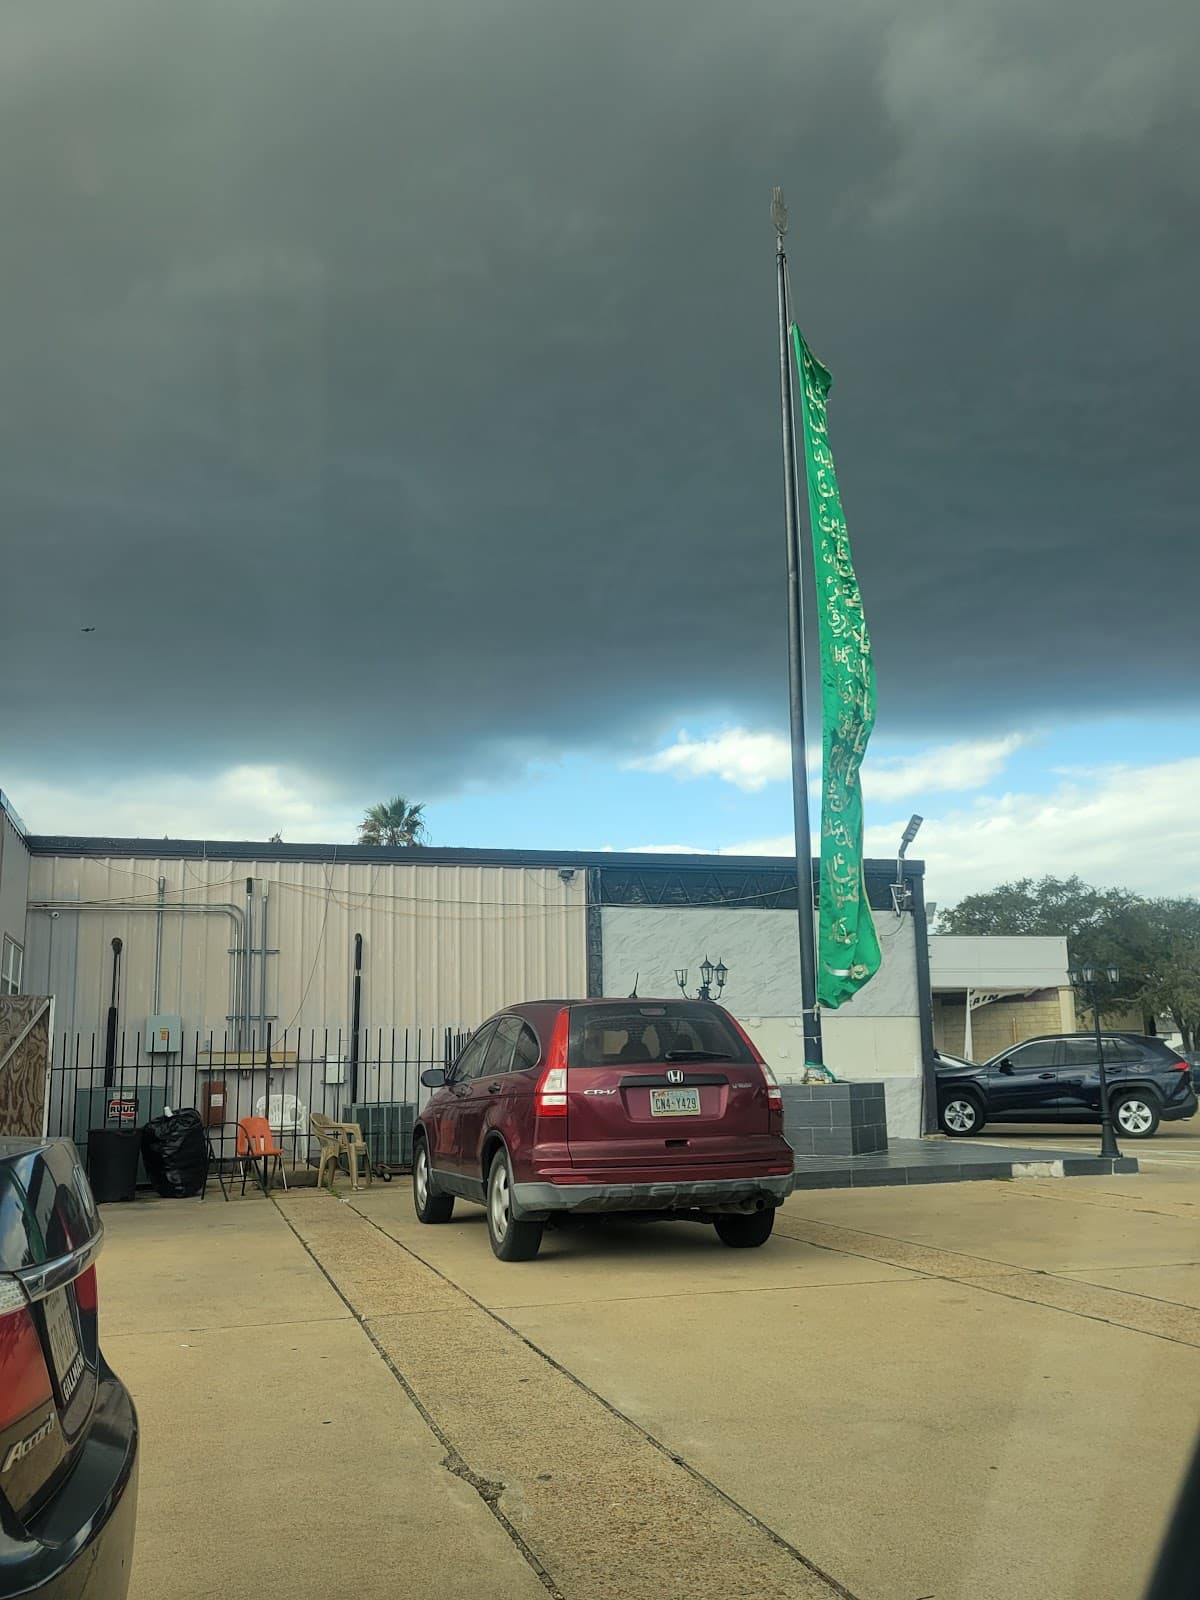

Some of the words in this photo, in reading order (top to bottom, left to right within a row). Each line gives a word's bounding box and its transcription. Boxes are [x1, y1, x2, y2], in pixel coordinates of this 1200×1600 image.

[110, 1105, 137, 1113] RUUD
[62, 1351, 85, 1401] GILLMAN
[1, 1412, 55, 1473] Accord
